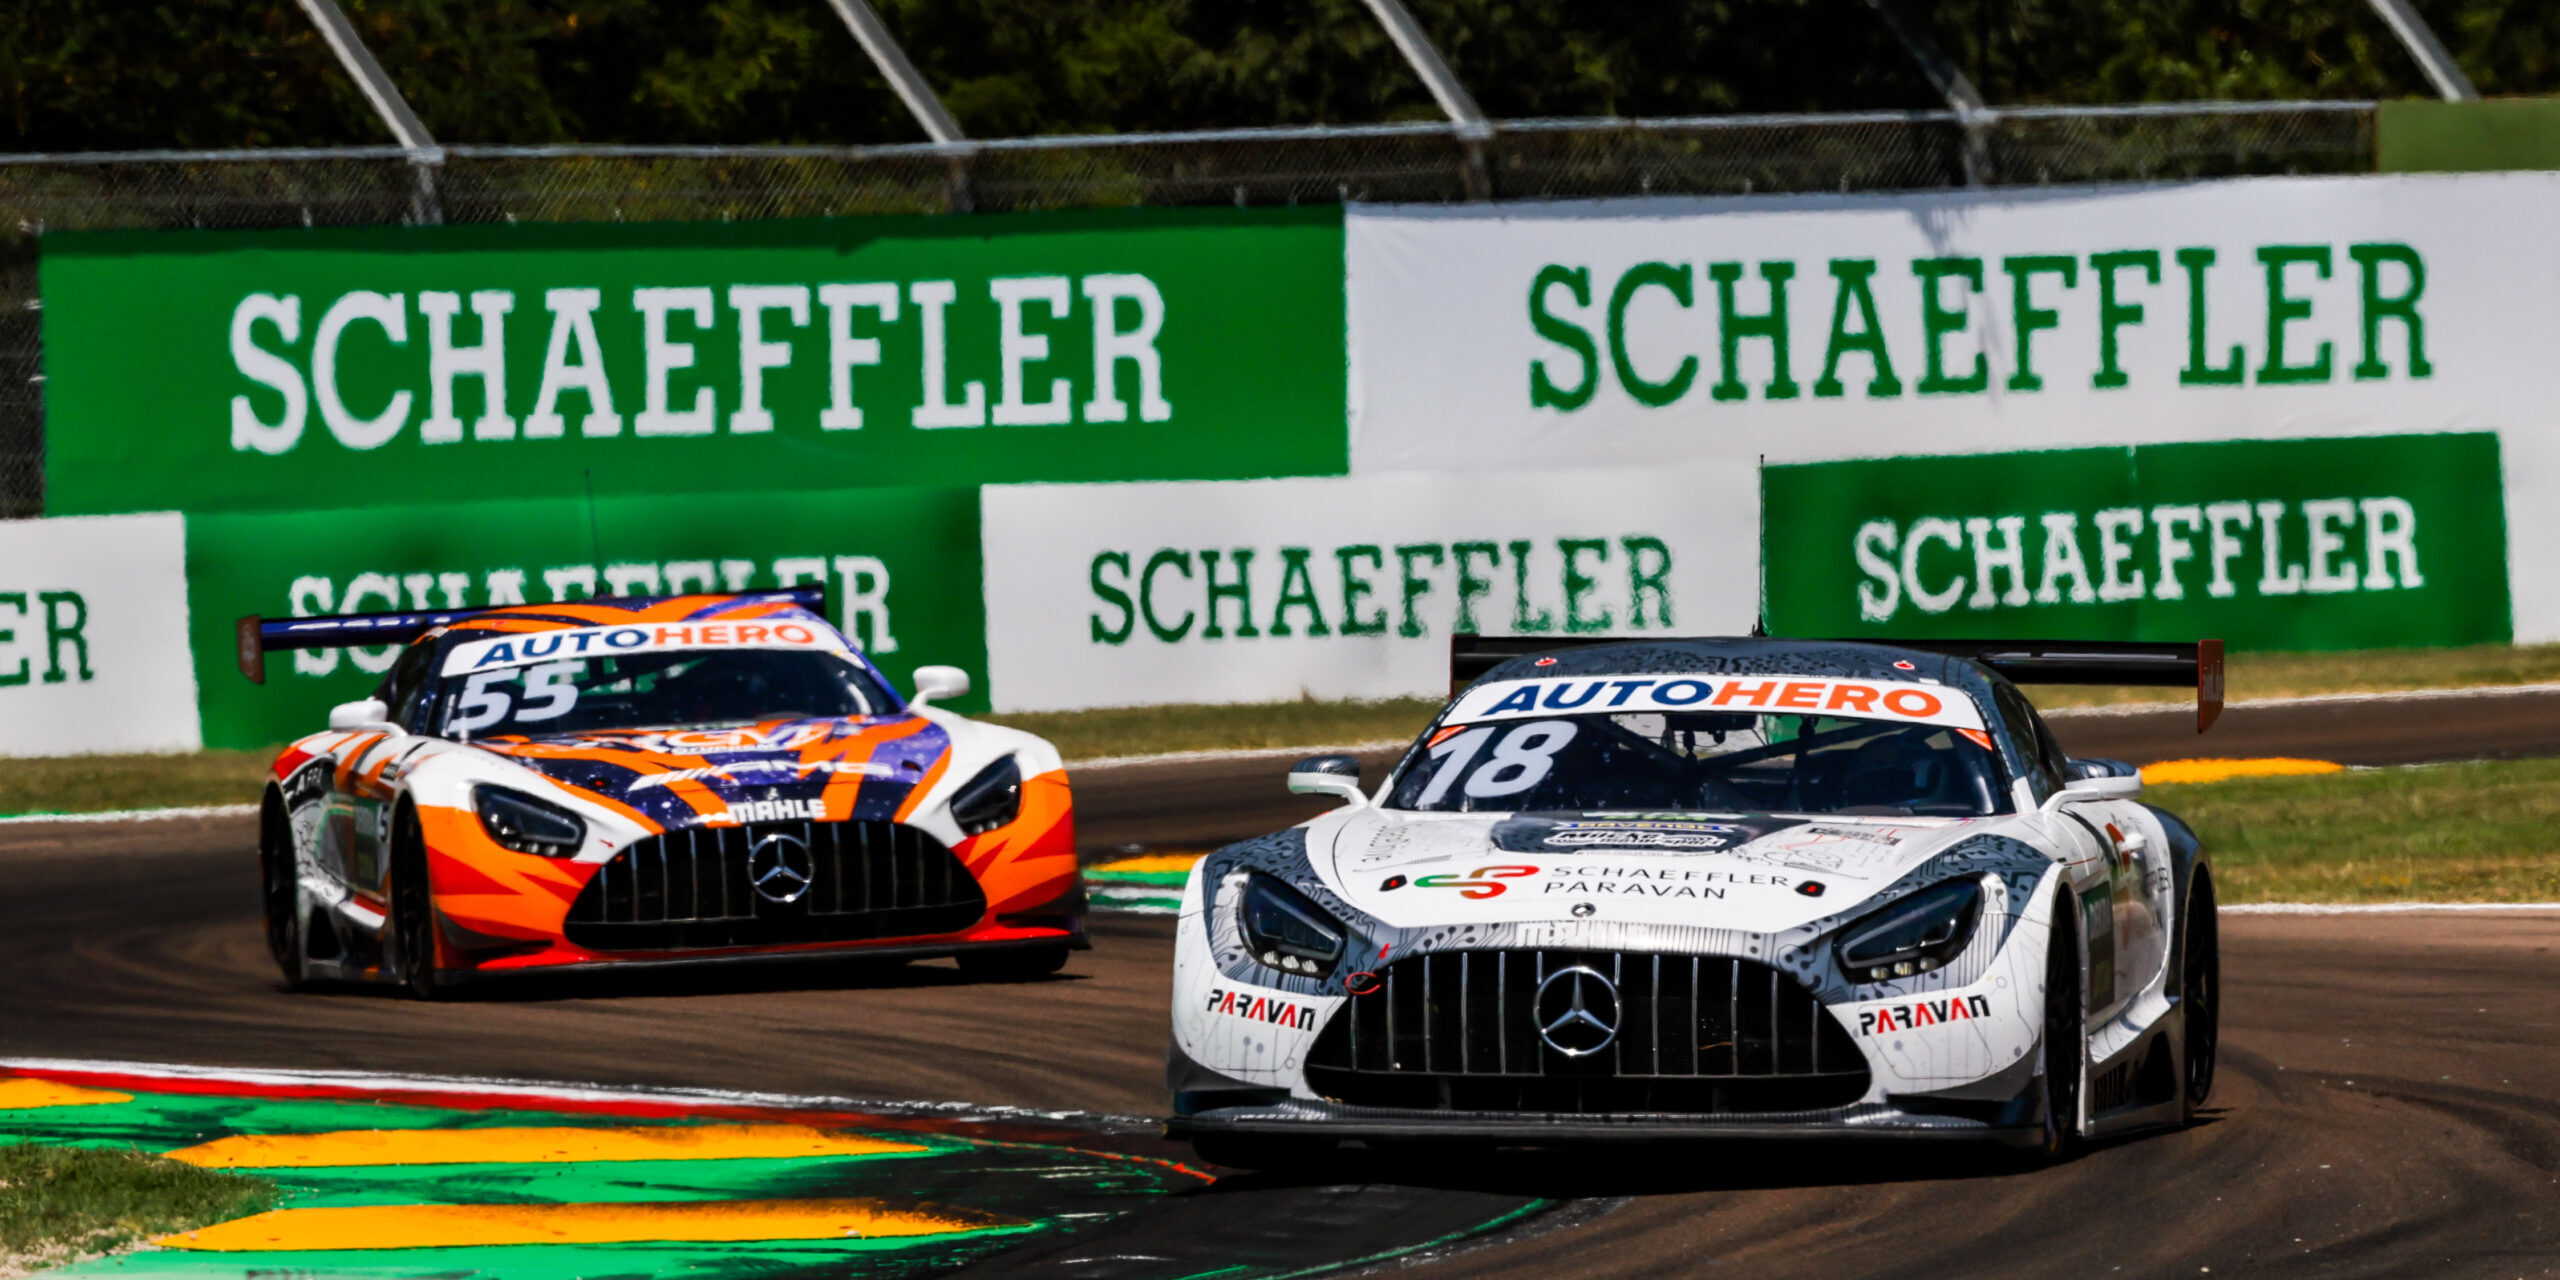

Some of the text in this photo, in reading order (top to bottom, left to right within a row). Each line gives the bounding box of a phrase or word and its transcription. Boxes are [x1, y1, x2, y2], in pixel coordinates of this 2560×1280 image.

[1528, 242, 2433, 413] SCHAEFFLER
[230, 273, 1172, 453] SCHAEFFLER
[1855, 496, 2425, 622] SCHAEFFLER
[1089, 534, 1675, 644] SCHAEFFLER
[475, 625, 815, 667] AUTOHERO
[448, 660, 580, 731] 55
[1482, 679, 1942, 717] AUTOHERO
[1416, 720, 1577, 807] 18
[728, 799, 827, 823] MAHLE
[1544, 881, 1725, 900] PARAVAN
[1554, 866, 1789, 887] SCHAEFFLER
[1207, 989, 1317, 1031] PARAVAN
[1859, 995, 1991, 1036] PARAVAN
